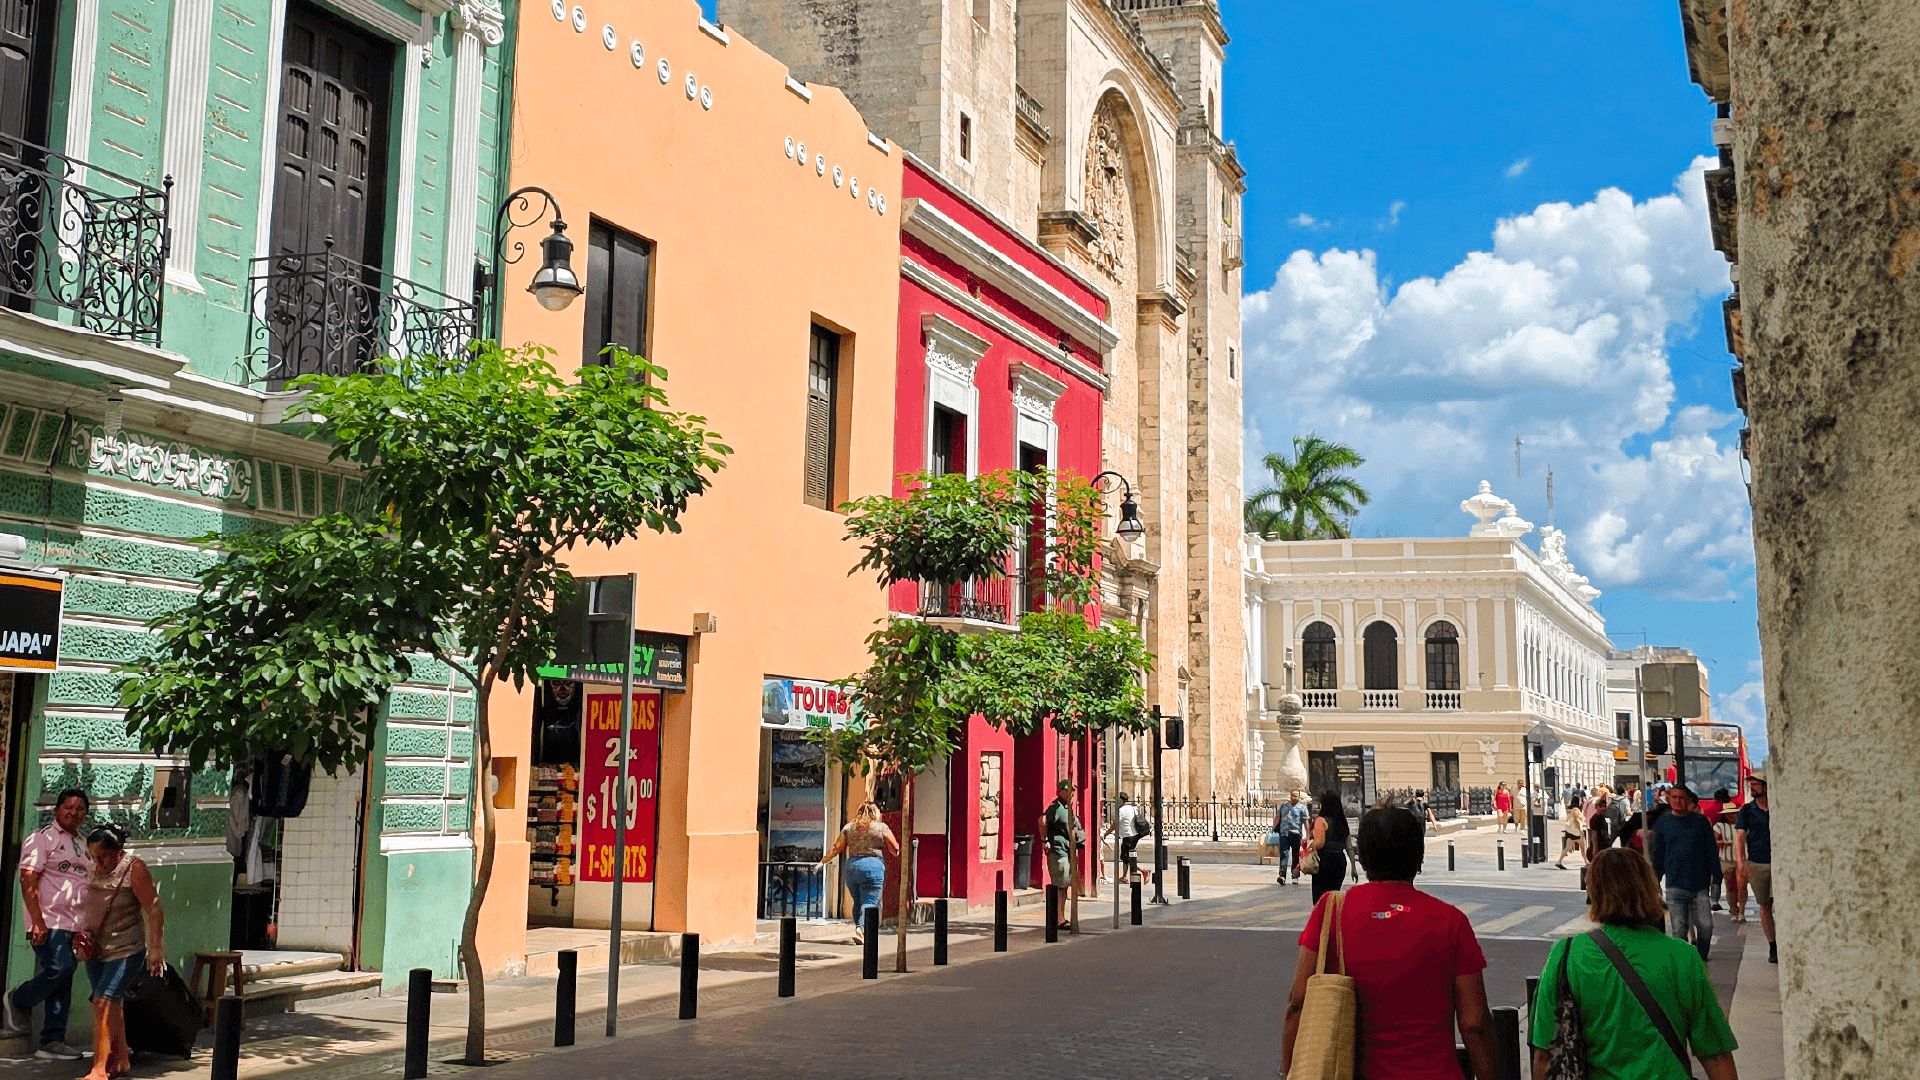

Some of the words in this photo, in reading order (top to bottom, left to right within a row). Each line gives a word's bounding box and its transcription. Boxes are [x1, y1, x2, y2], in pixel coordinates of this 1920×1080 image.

[590, 700, 655, 730] PLAYRAS
[791, 686, 848, 715] TOURS
[588, 844, 647, 878] T-SHRTS
